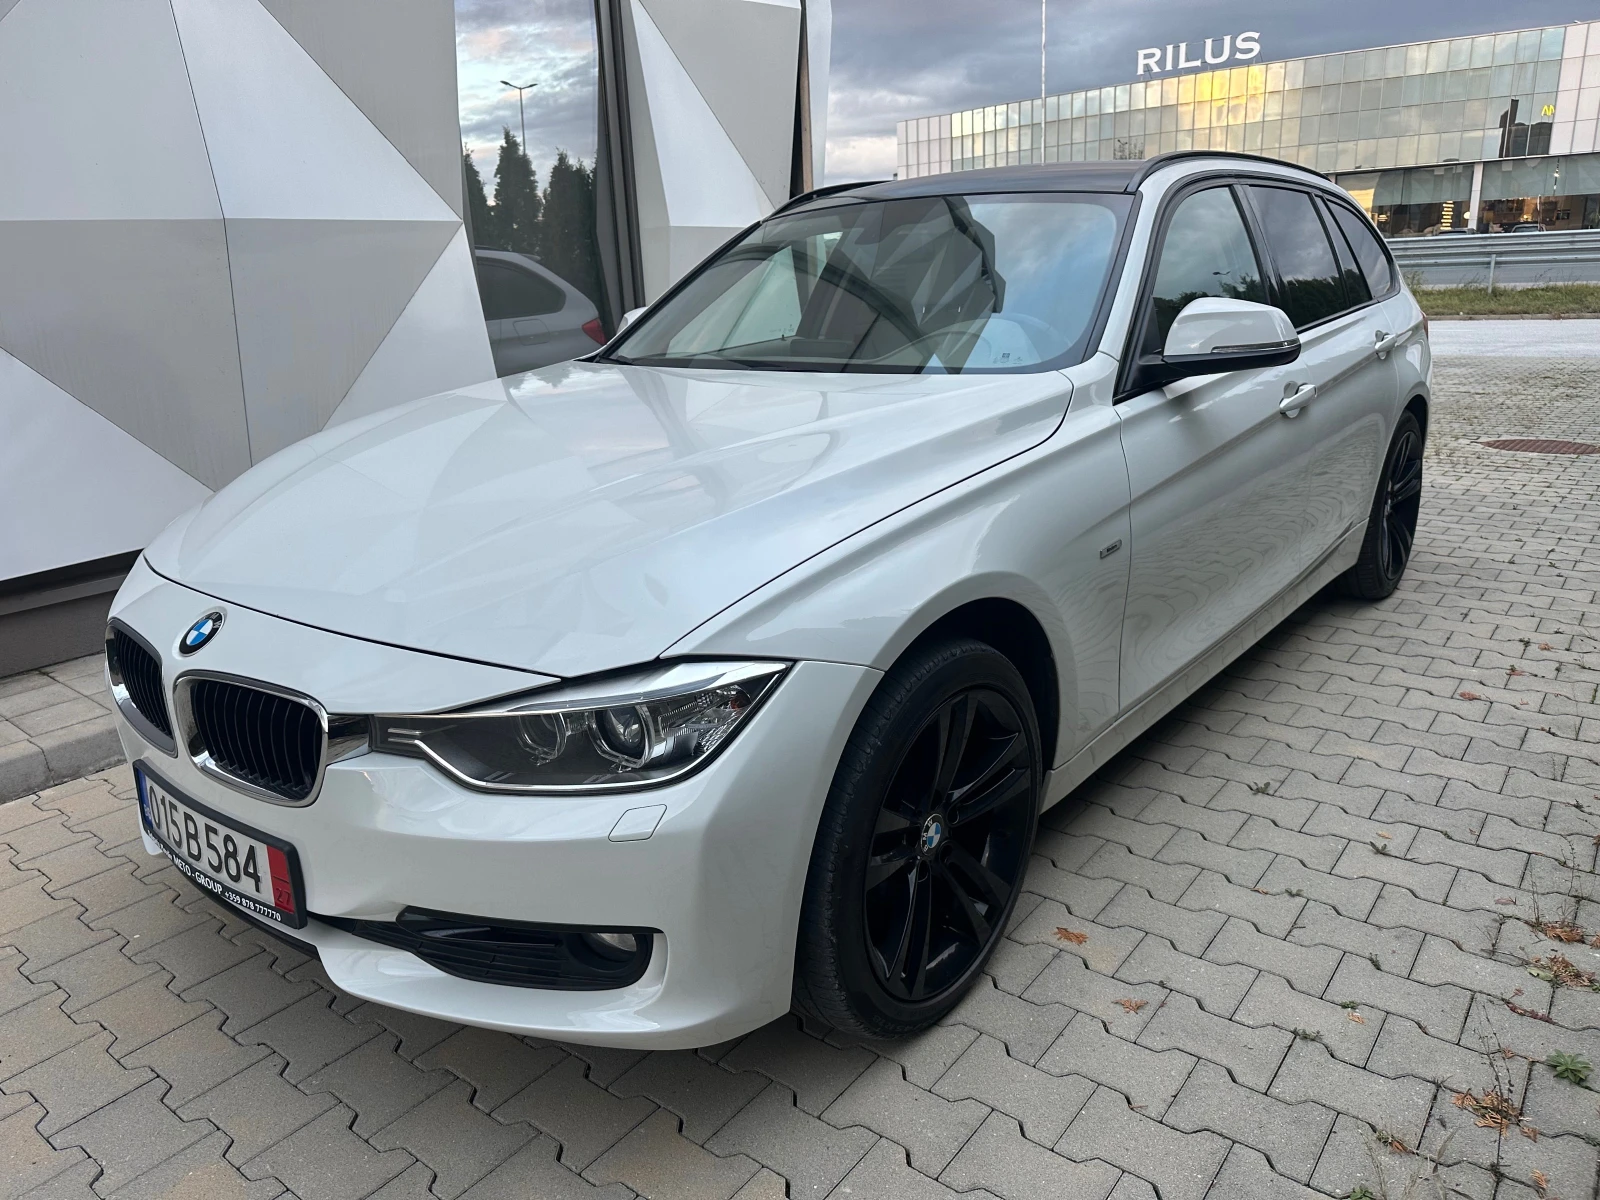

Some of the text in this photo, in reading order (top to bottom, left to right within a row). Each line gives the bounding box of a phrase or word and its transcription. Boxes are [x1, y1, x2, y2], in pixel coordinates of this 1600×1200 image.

[1136, 31, 1261, 75] RILUS
[922, 819, 933, 852] BMW
[195, 871, 223, 895] GROUP
[225, 891, 241, 905] +359
[241, 898, 255, 910] 878
[275, 887, 291, 906] 27
